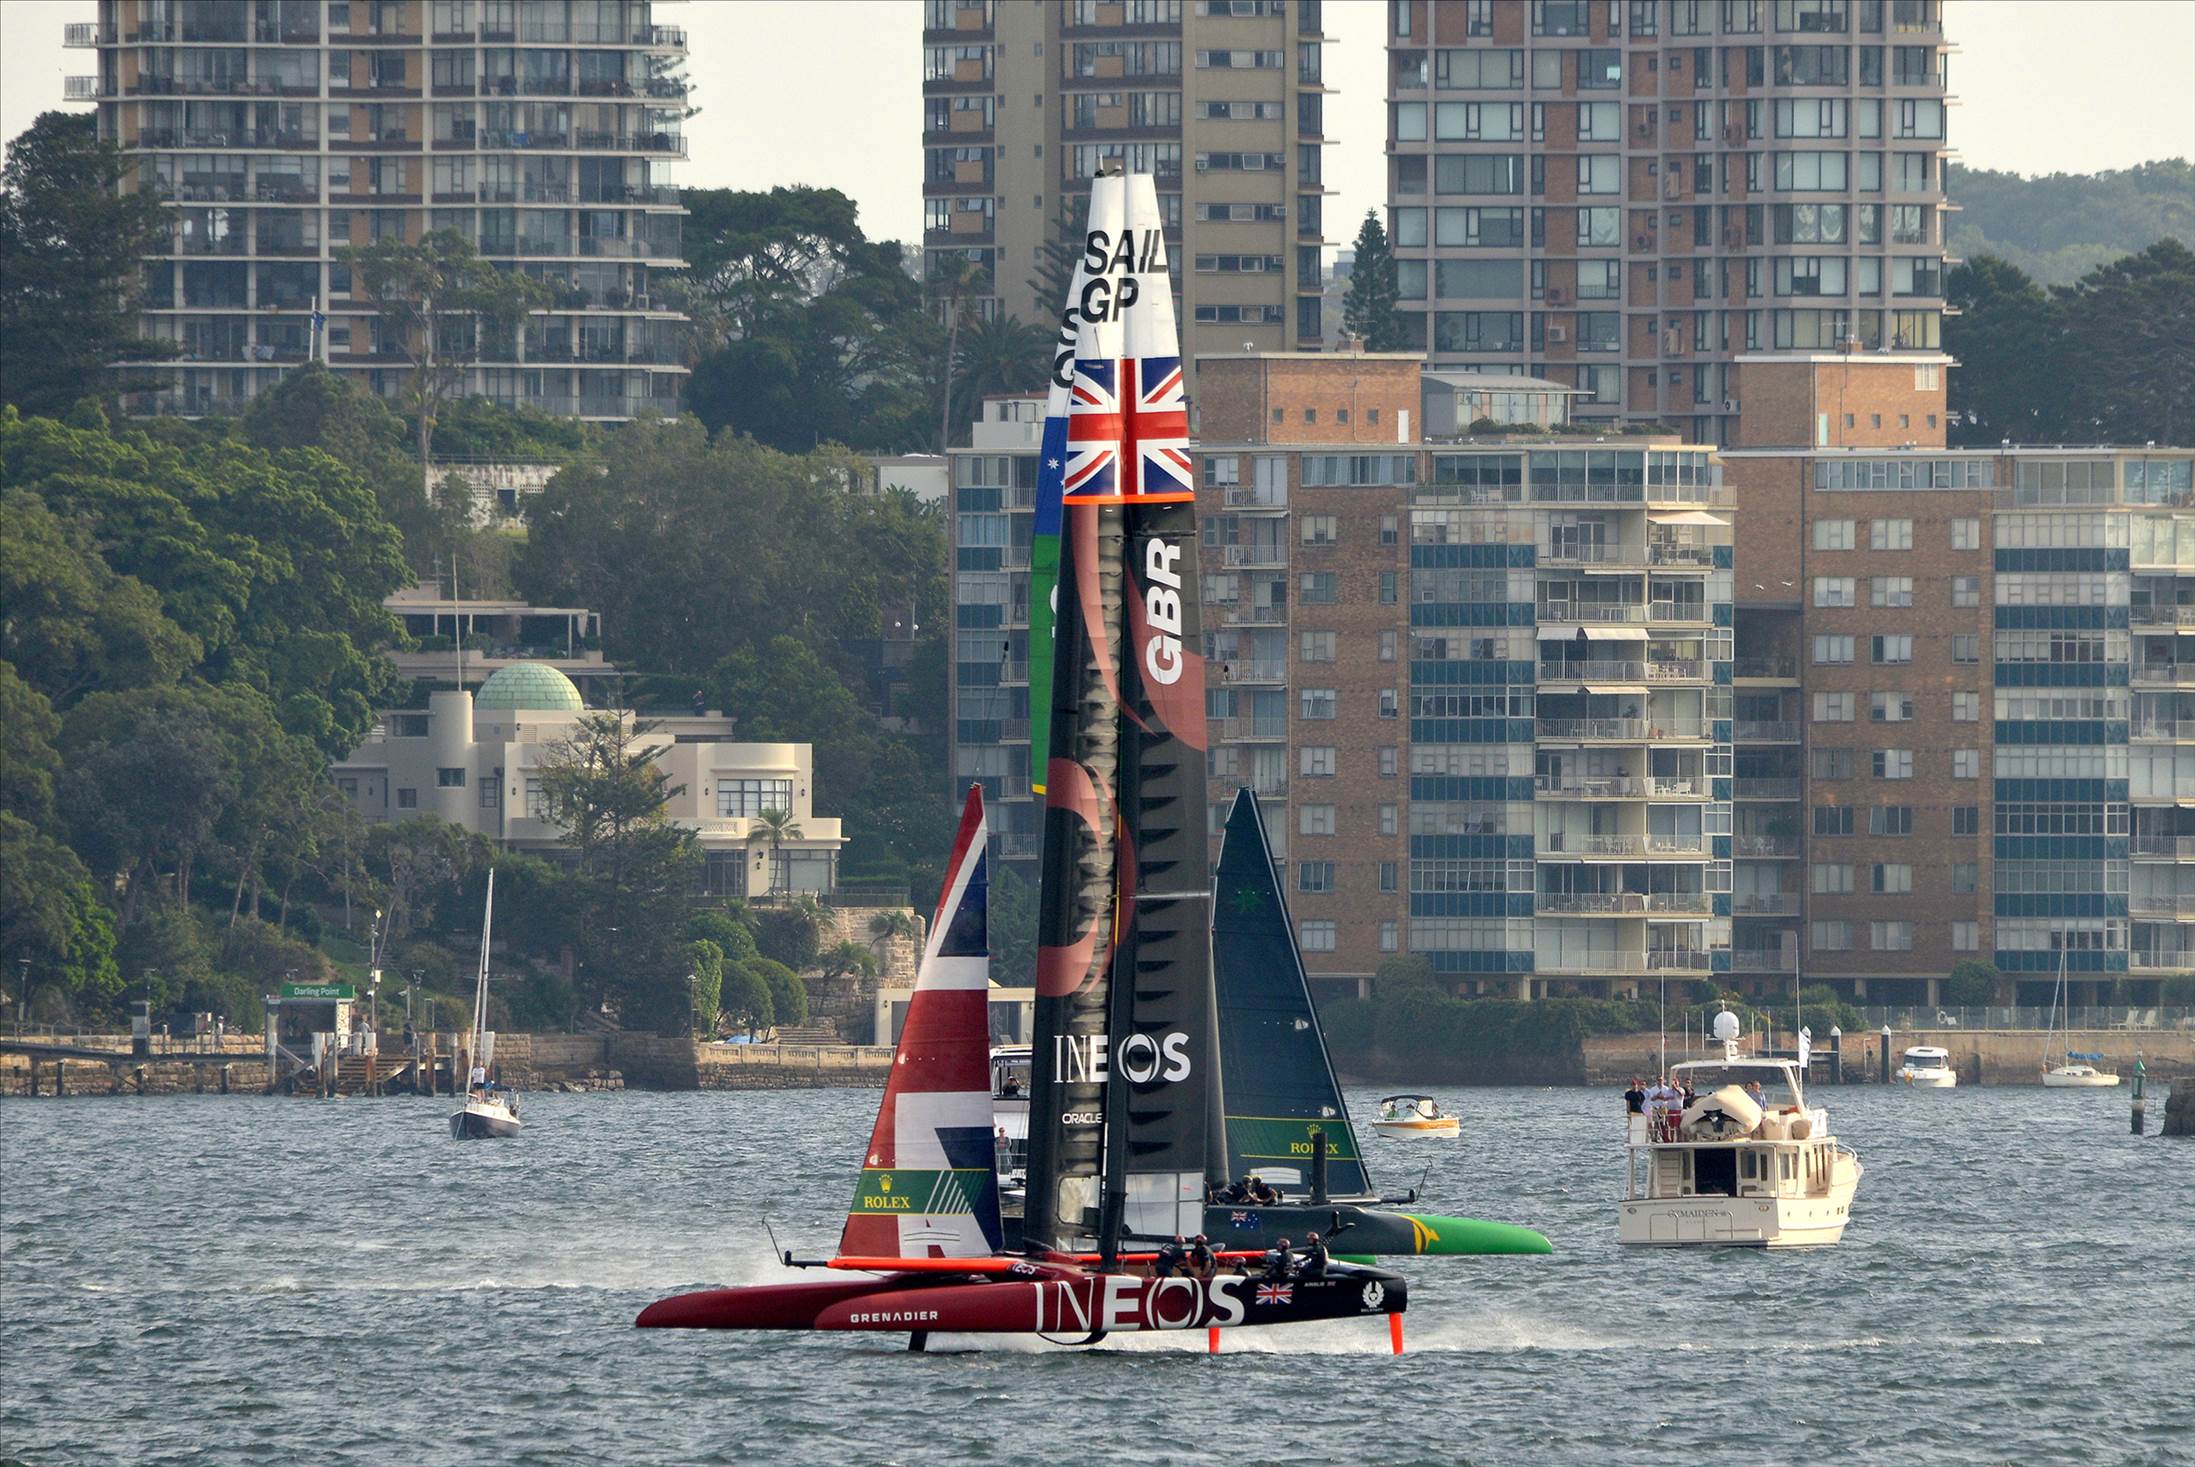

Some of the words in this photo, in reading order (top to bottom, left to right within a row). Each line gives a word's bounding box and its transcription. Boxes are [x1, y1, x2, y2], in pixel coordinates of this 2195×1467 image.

[1083, 229, 1168, 276] SAIL
[1079, 277, 1139, 323] GP
[1146, 538, 1183, 685] GBR
[294, 987, 319, 997] Darling
[320, 987, 339, 996] Point
[1053, 1032, 1191, 1083] INEOS
[1061, 1112, 1102, 1124] ORACLE
[1290, 1142, 1338, 1154] ROLX
[863, 1195, 911, 1208] ROLEX
[850, 1310, 939, 1323] GRENADIER
[1029, 1275, 1248, 1332] INEOS
